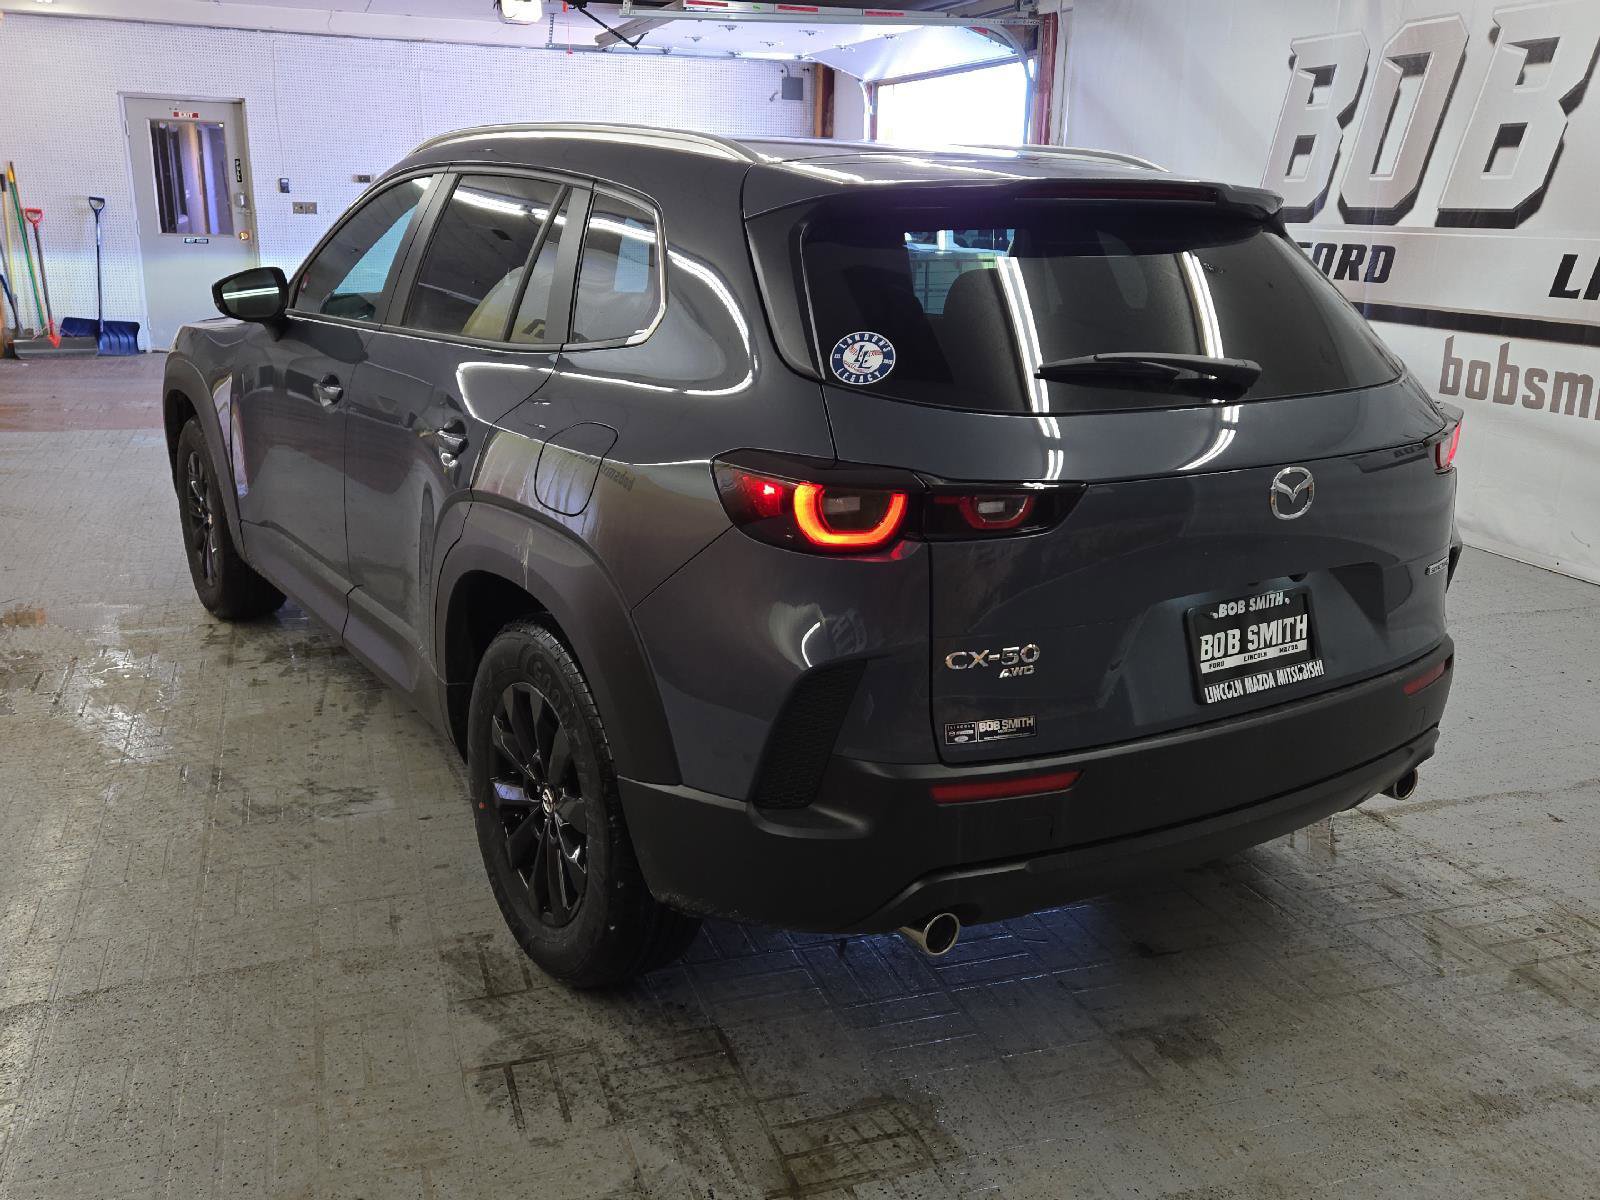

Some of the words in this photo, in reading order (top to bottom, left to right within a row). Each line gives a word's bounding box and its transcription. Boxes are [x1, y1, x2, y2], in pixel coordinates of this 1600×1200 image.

[1262, 3, 1600, 229] BOB
[837, 367, 881, 383] LEGACY
[1219, 600, 1246, 618] BOB
[1249, 591, 1284, 612] SMITH
[1200, 628, 1241, 661] BOB
[1247, 614, 1308, 651] SMITH
[944, 643, 1041, 670] CX-50
[1208, 660, 1225, 670] FORD
[1243, 651, 1268, 662] LINCOLN
[998, 664, 1035, 678] AWD
[1244, 672, 1276, 695] MAZDA
[978, 720, 1001, 733] BOB
[1001, 717, 1034, 729] SMITH
